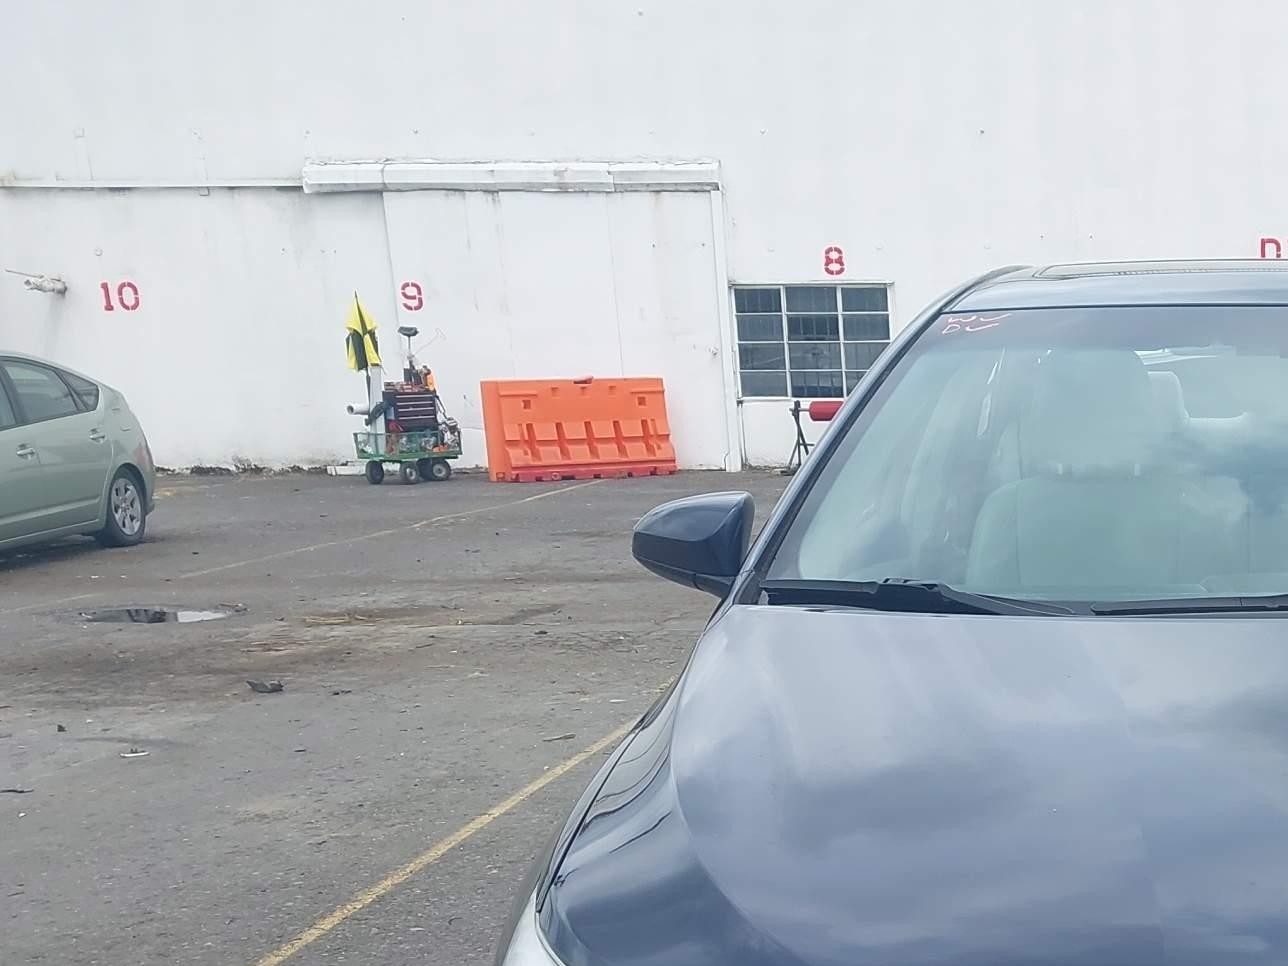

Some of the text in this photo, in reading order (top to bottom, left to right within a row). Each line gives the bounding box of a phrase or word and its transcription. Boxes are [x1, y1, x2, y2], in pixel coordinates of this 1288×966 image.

[823, 247, 845, 277] 8
[100, 281, 140, 312] 10
[401, 282, 424, 311] 9
